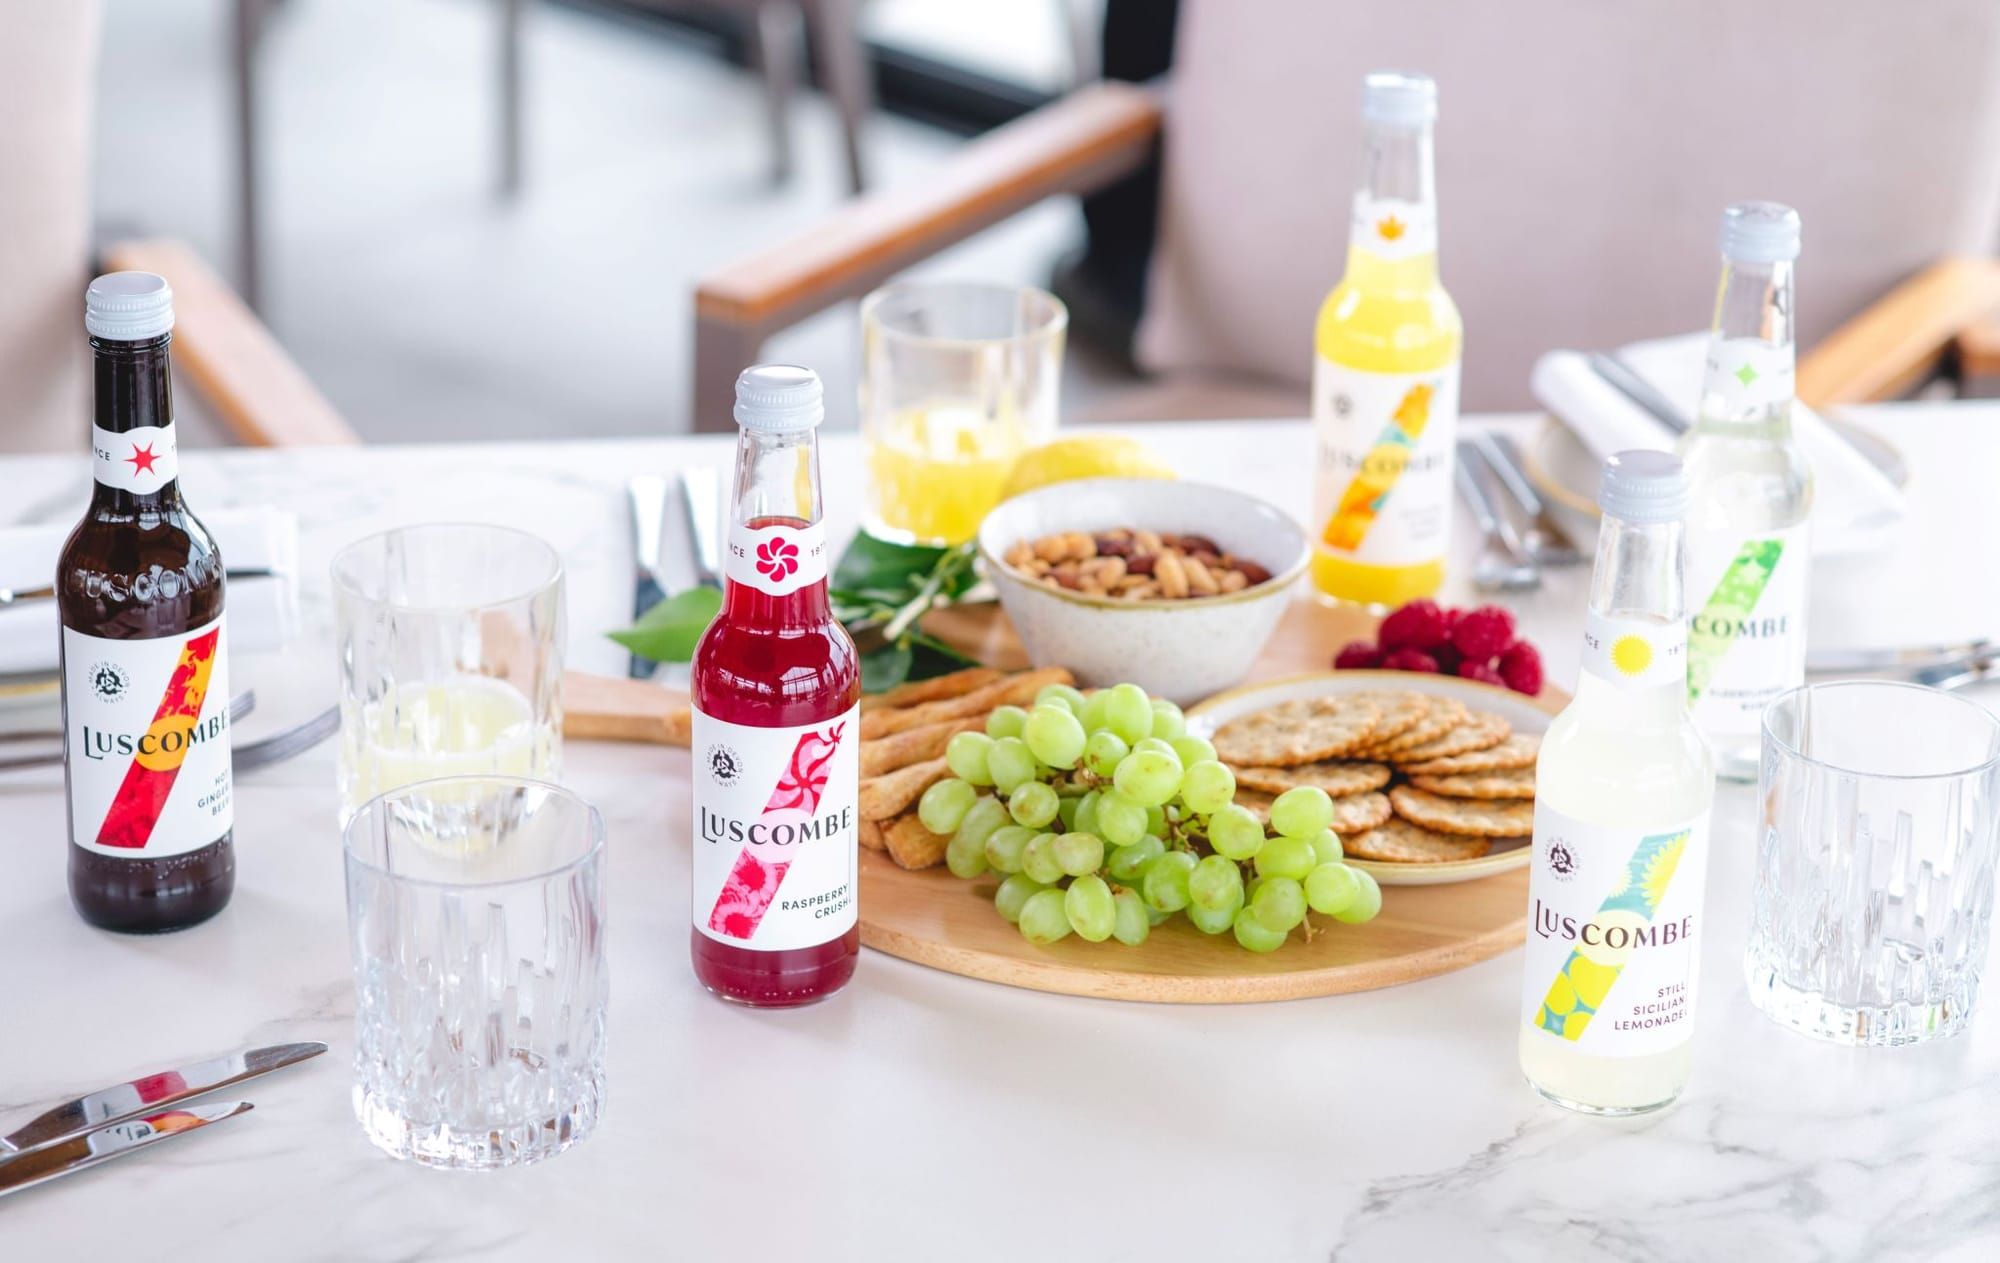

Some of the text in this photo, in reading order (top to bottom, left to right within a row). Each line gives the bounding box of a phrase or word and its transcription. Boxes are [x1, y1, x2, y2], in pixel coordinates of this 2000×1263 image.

[701, 805, 850, 846] LUSCOMBE
[782, 883, 848, 911] RASPBERRY
[815, 896, 849, 919] CRUSH
[1535, 898, 1693, 949] LUSCOMBE
[1657, 981, 1685, 998] STILL
[1633, 995, 1685, 1016] SICILIAN
[1614, 1008, 1684, 1031] LEMONADE
